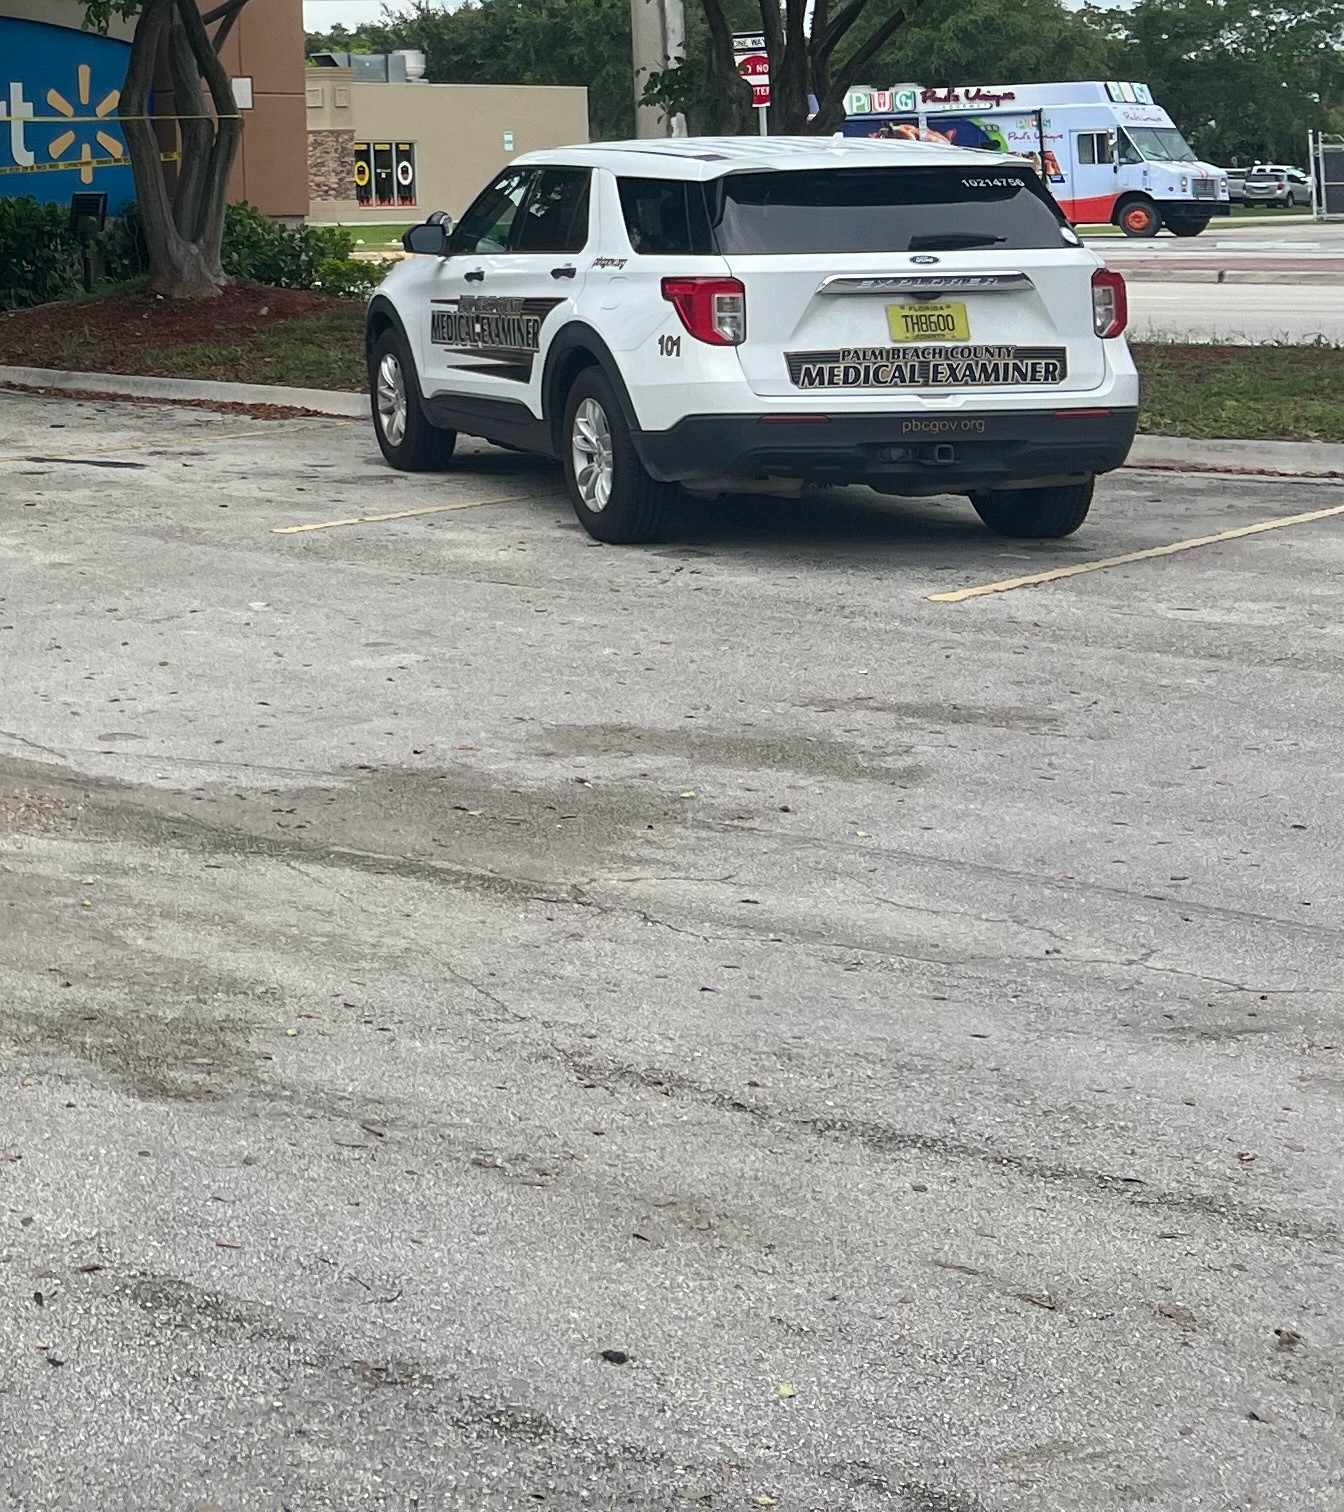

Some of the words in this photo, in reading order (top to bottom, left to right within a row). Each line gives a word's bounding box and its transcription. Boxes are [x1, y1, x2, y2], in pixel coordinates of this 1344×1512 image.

[756, 64, 769, 73] NO
[852, 90, 916, 112] PUG
[856, 277, 999, 289] EXPLORER
[901, 314, 955, 333] TH8600
[658, 335, 681, 357] 101
[840, 347, 885, 362] PALM
[890, 346, 944, 361] BEACH
[949, 345, 1015, 360] COUNTY
[799, 363, 923, 387] MEDICAL
[929, 360, 1060, 385] EXAMINER
